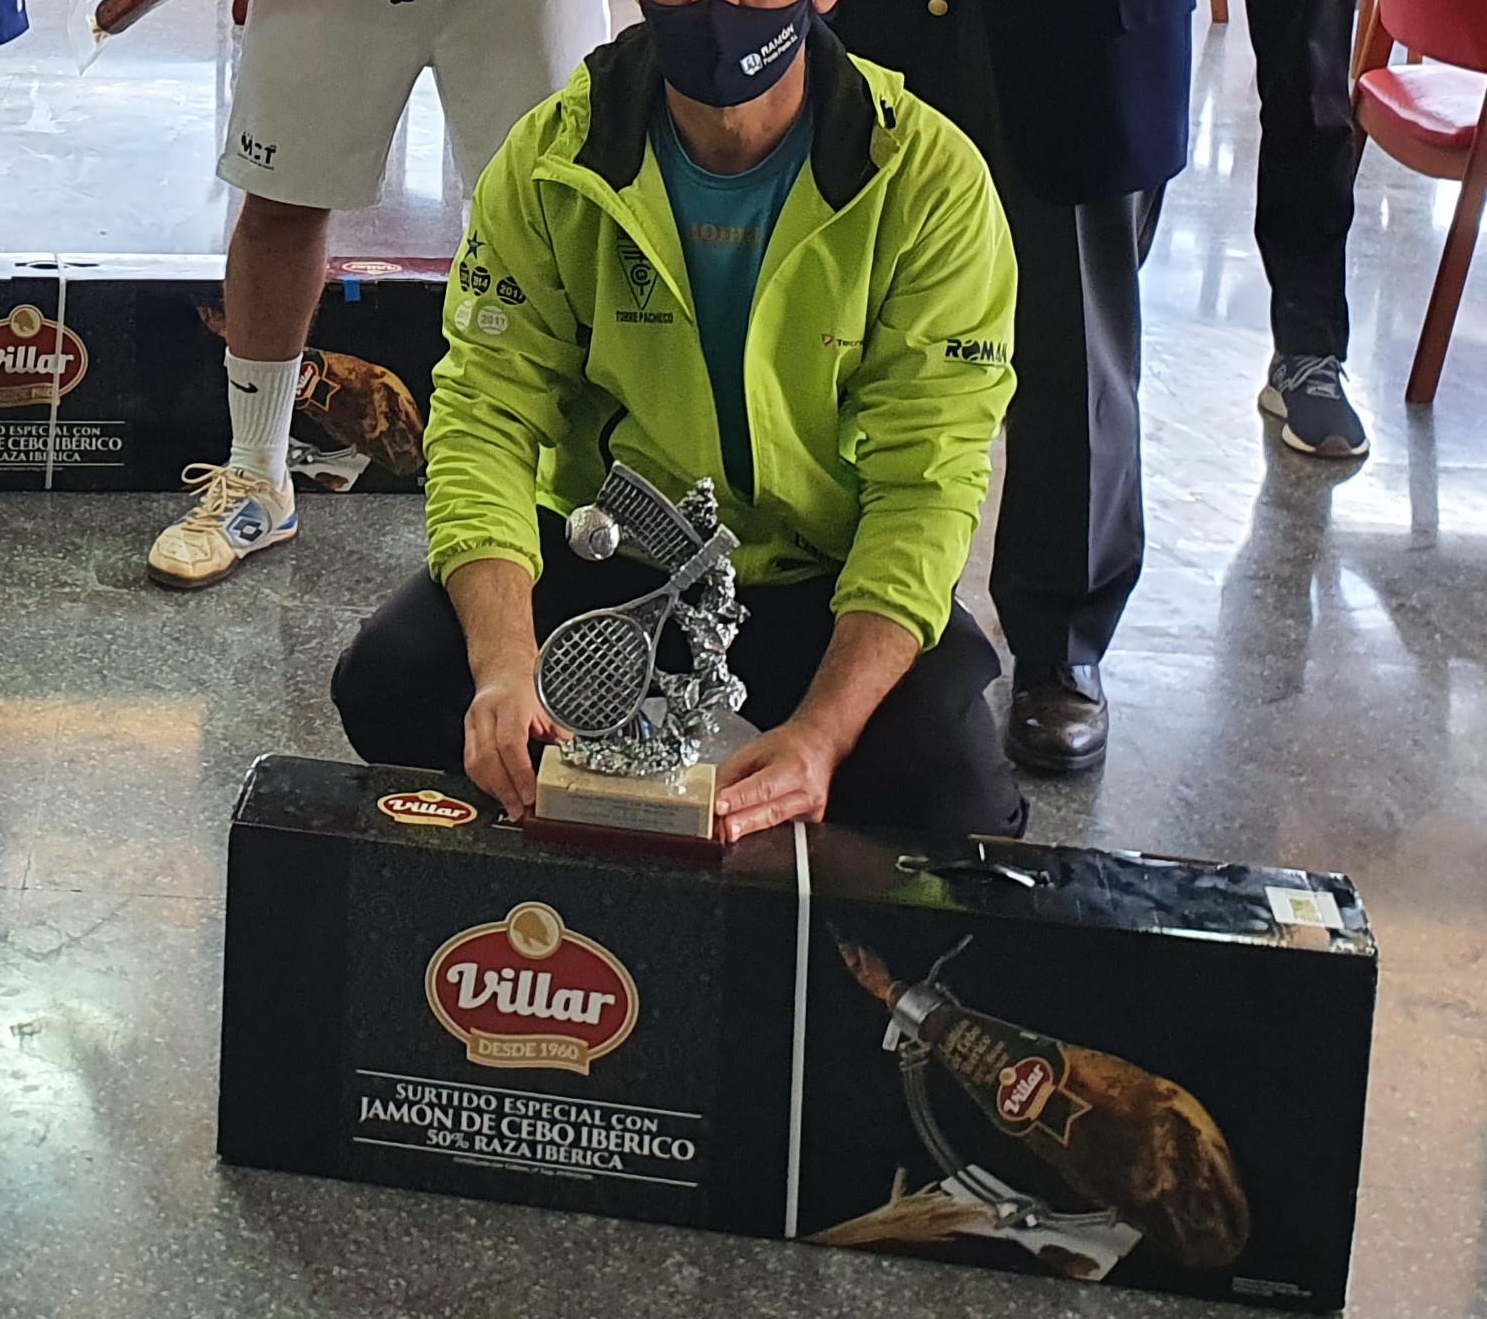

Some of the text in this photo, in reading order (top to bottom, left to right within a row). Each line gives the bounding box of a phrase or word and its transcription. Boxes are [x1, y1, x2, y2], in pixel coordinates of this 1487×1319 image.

[639, 311, 674, 324] PACHECO
[9, 425, 70, 436] ESPECAL
[73, 427, 101, 436] CON
[7, 437, 51, 451] CEBO
[55, 434, 122, 451] IBÉRICO
[29, 451, 81, 462] IBRICA
[388, 799, 467, 818] Villar
[446, 962, 615, 1025] Villar
[478, 1039, 579, 1060] DESDE 1960
[1003, 1064, 1044, 1114] Villar
[396, 1083, 659, 1132] SURTIDO ESPECIAL CON
[359, 1096, 695, 1161] JAMÓN DE CEBO IBÉRICO
[426, 1129, 469, 1149] 50%
[474, 1136, 532, 1159] RAZA
[536, 1143, 624, 1170] IBÉRICA
